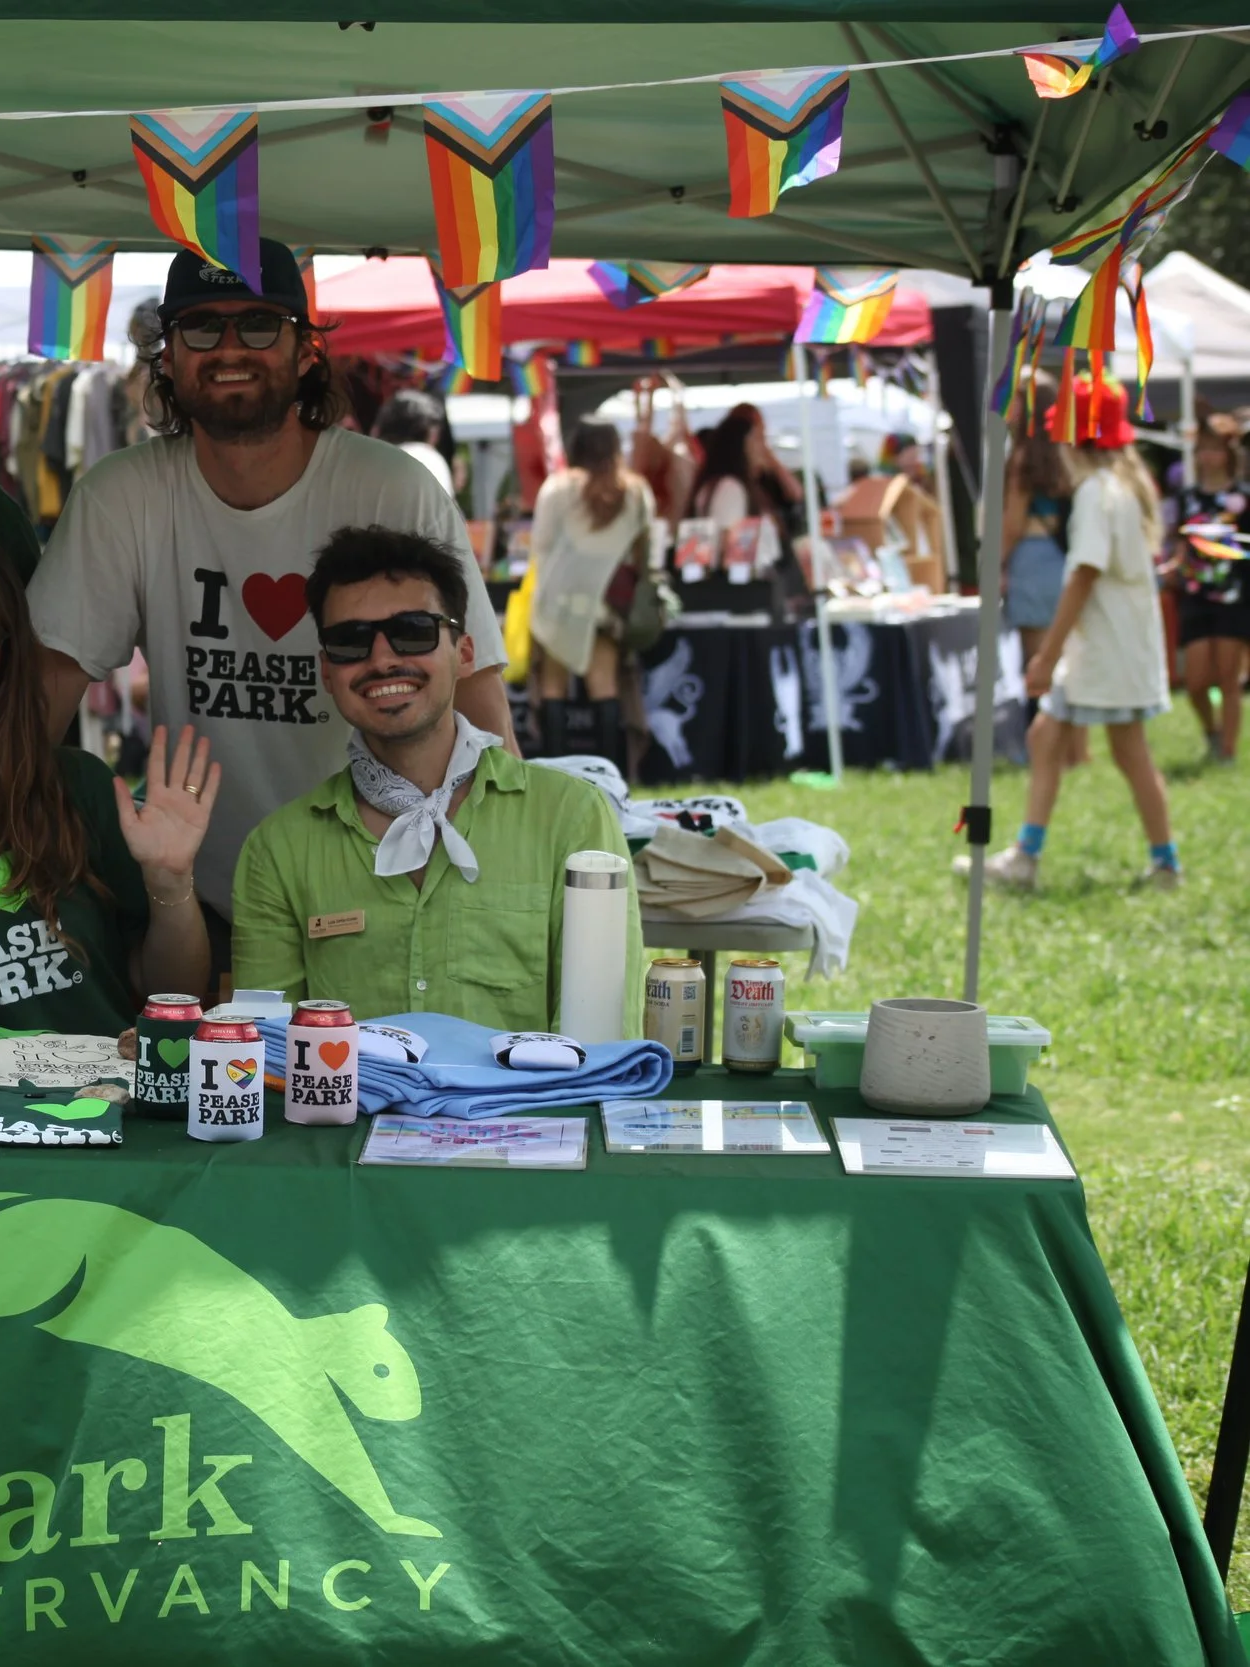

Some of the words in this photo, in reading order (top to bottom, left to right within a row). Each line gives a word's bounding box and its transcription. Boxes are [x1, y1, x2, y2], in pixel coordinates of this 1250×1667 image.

[210, 274, 243, 284] TEXA
[189, 567, 229, 640] I
[185, 645, 317, 686] PEASE
[186, 678, 318, 724] PARK
[646, 980, 671, 1000] eath
[730, 979, 775, 1001] Death
[138, 1035, 152, 1067] I
[293, 1040, 311, 1071] I
[201, 1059, 219, 1090] I
[292, 1073, 352, 1090] PEASE
[198, 1091, 260, 1109] PEASE
[291, 1087, 352, 1106] PARK
[198, 1106, 261, 1126] PARK
